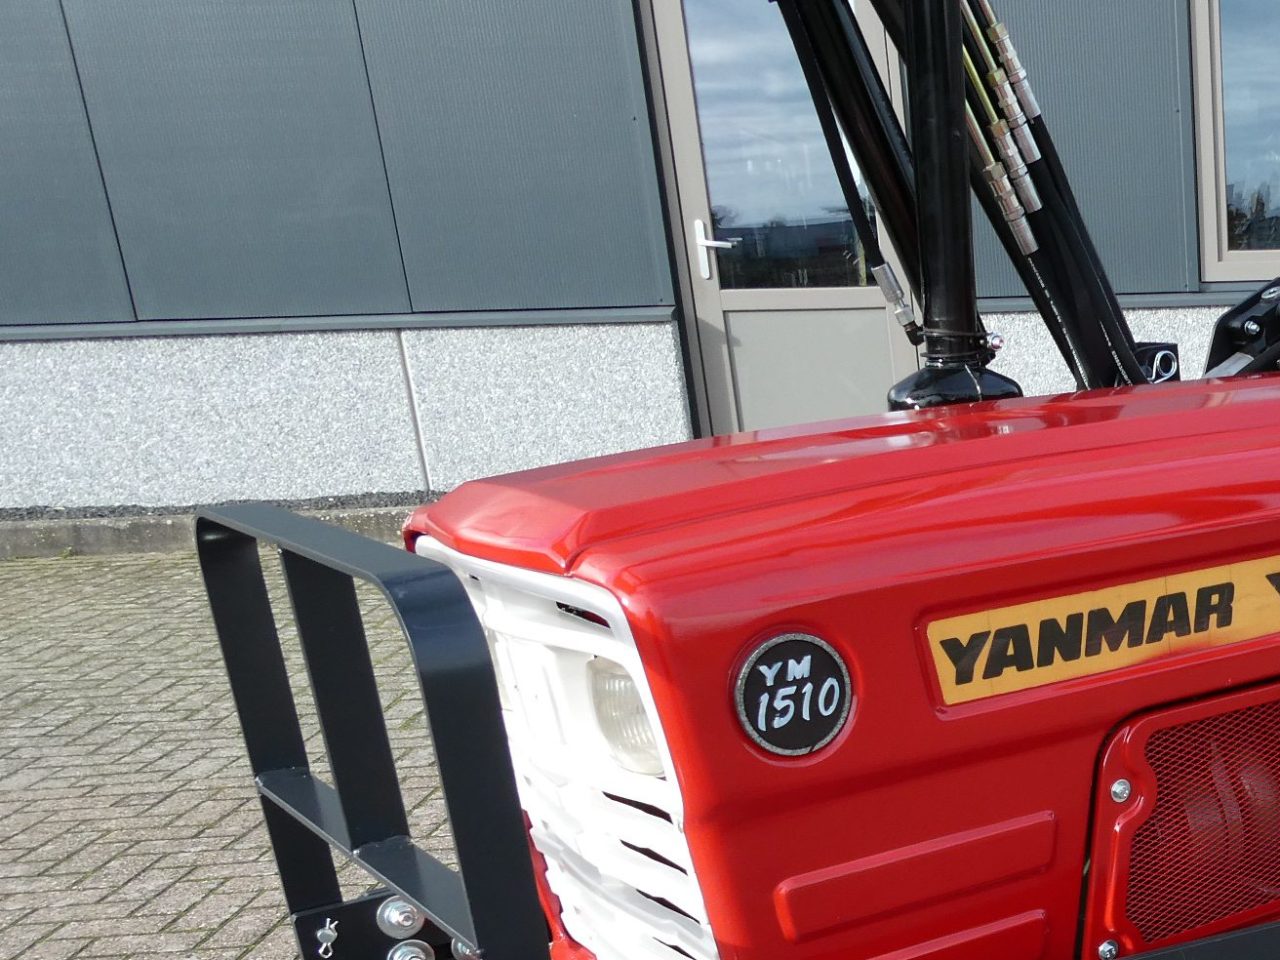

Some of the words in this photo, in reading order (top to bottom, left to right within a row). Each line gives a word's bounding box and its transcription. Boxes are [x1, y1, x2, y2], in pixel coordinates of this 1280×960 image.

[939, 581, 1236, 687] YANMAR
[757, 654, 811, 686] YM
[757, 677, 840, 732] 1510
